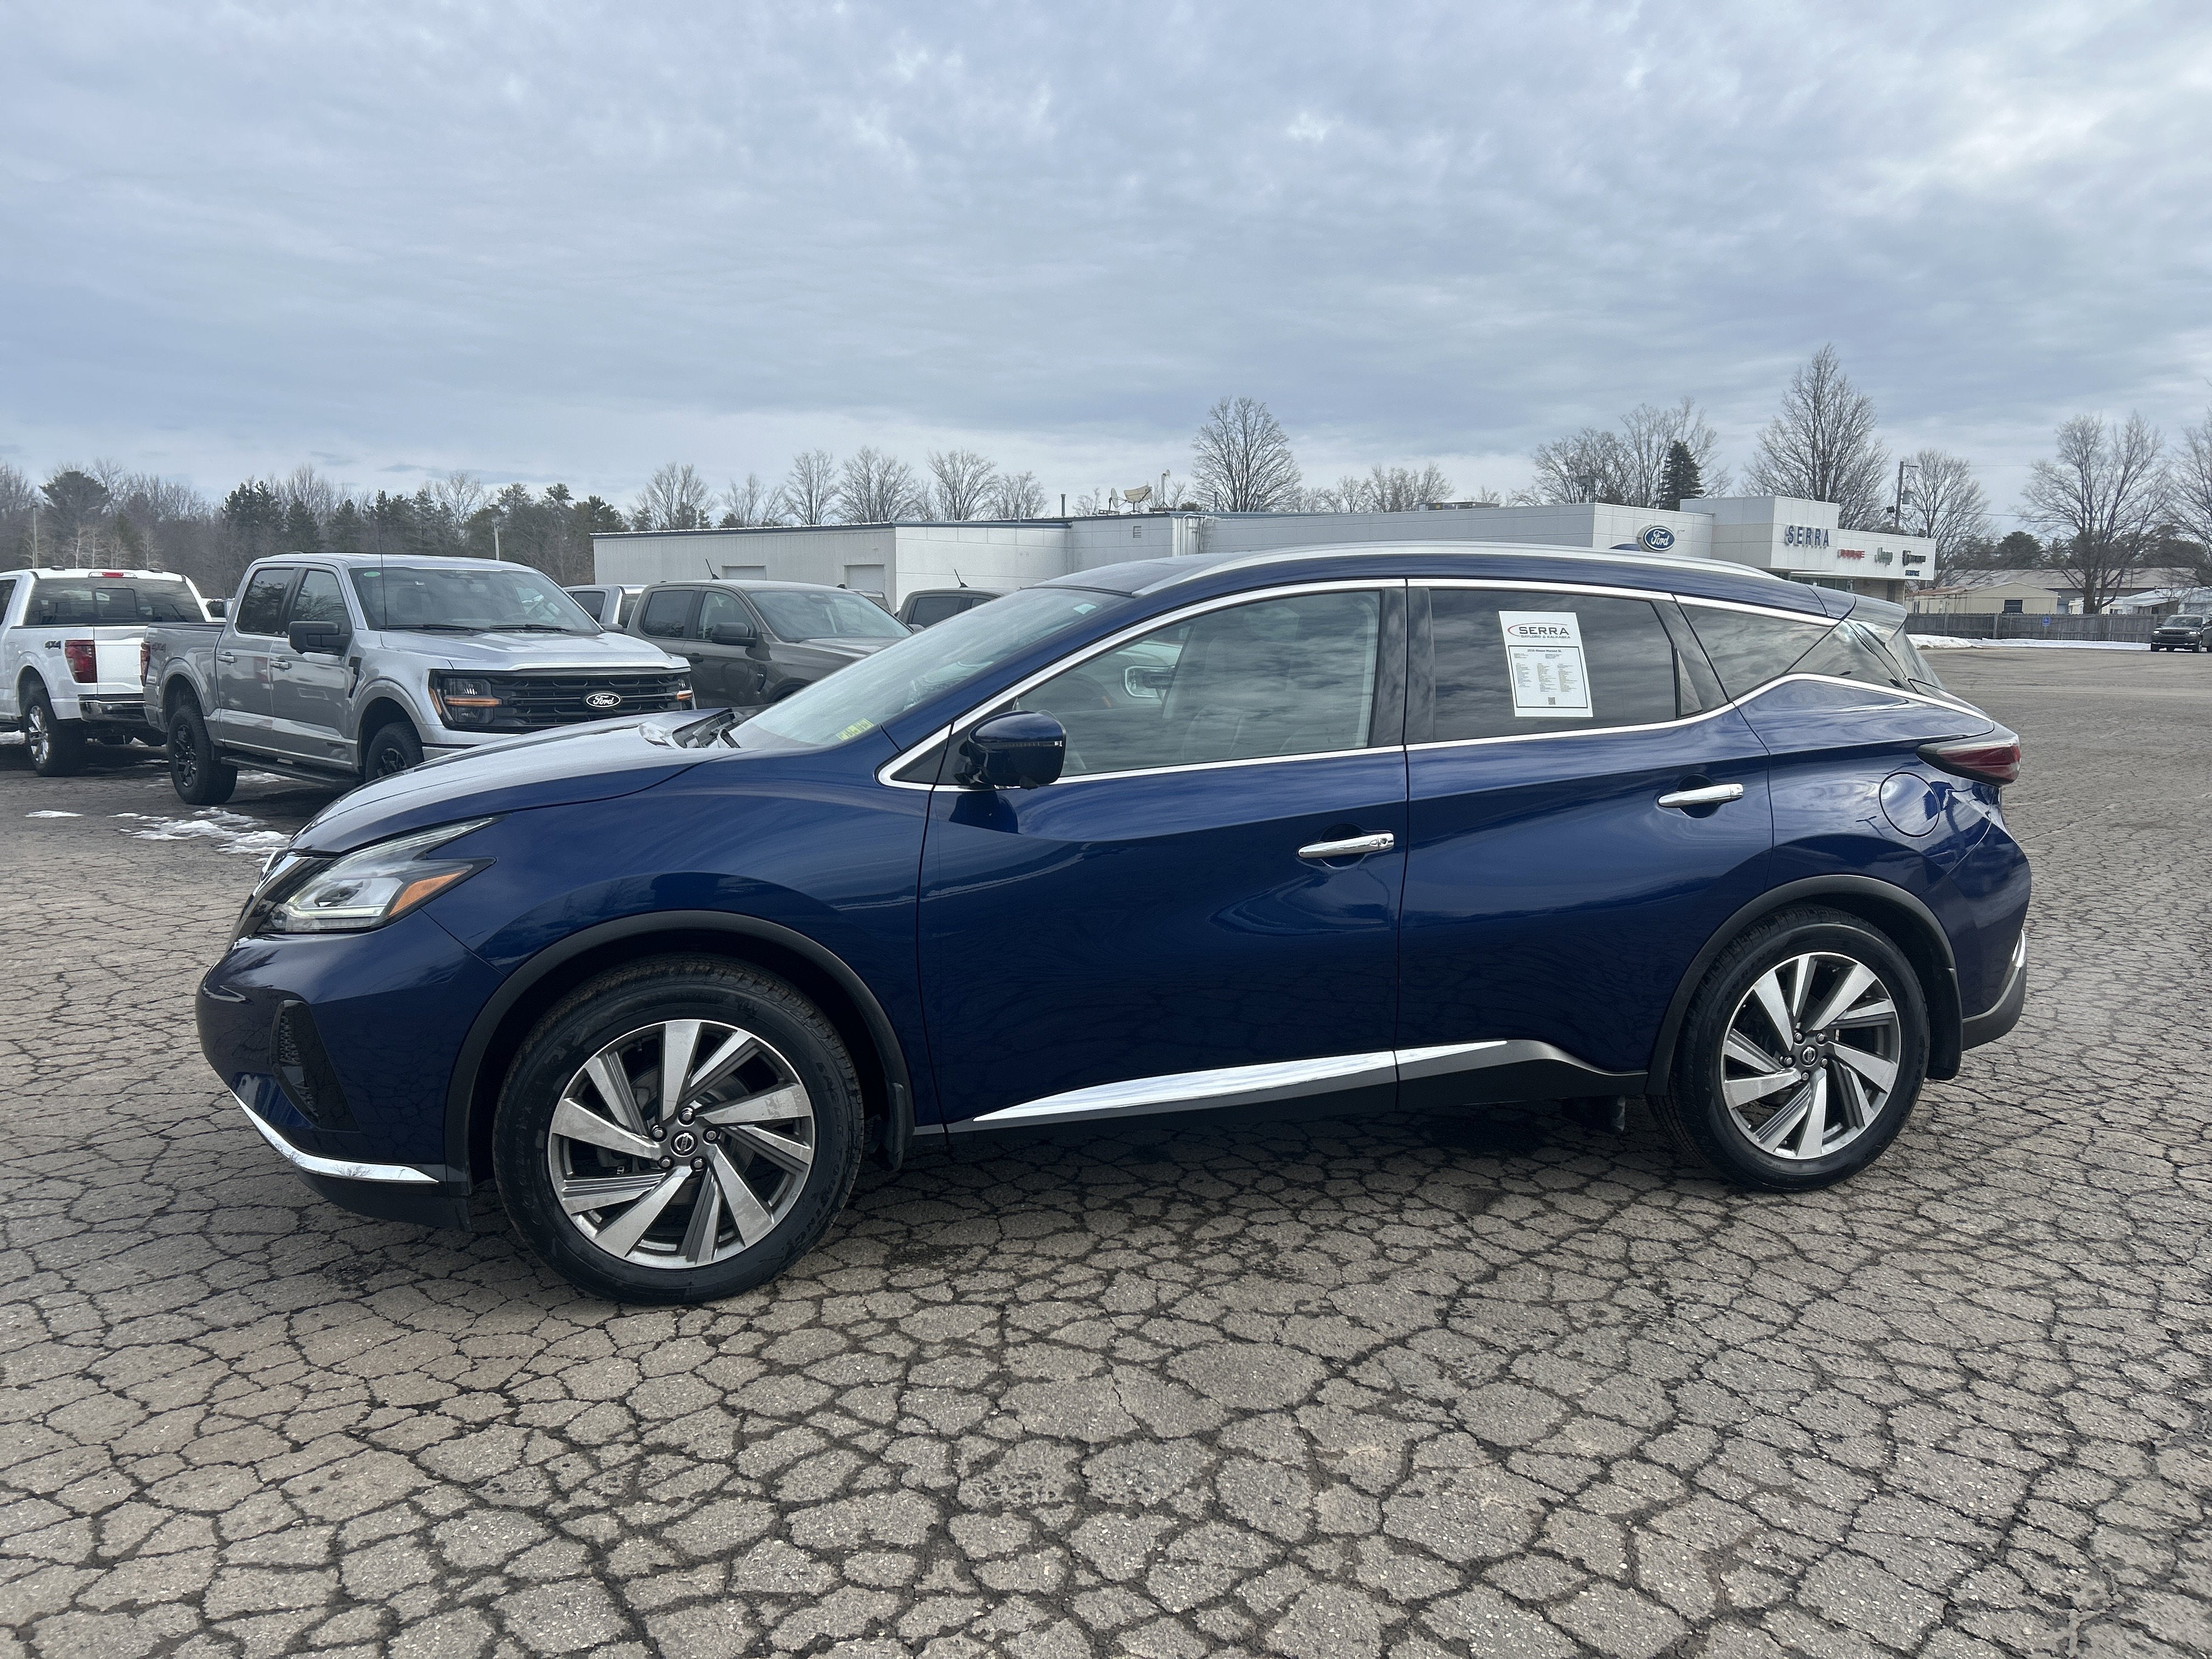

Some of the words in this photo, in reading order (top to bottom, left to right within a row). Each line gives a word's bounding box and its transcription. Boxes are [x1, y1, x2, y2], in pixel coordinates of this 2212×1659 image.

[1651, 530, 1670, 546] Ford
[1787, 525, 1830, 547] SERRA
[1519, 627, 1570, 635] SERRA
[593, 695, 614, 705] Ford
